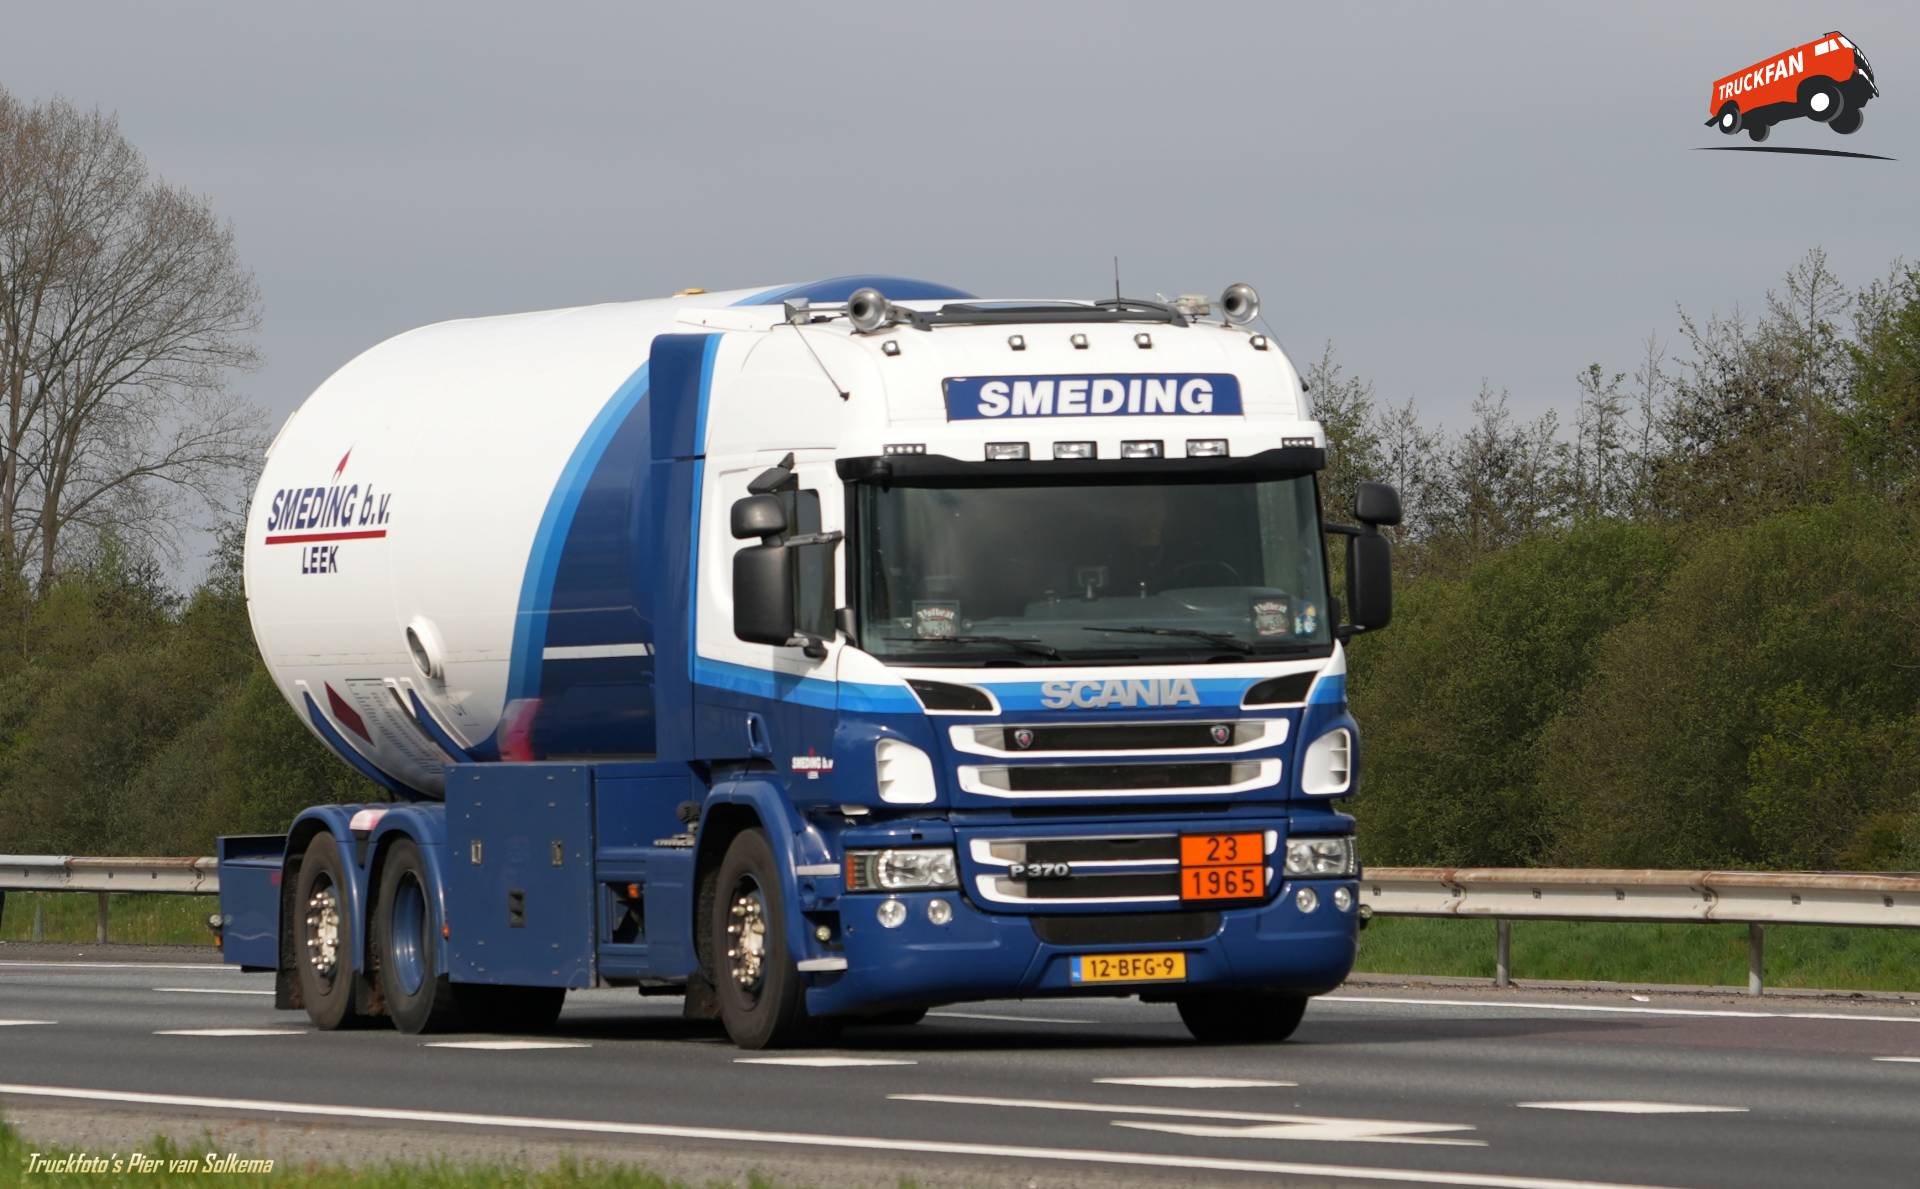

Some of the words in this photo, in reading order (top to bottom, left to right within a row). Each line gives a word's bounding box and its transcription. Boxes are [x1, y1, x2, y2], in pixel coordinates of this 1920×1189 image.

[977, 378, 1214, 417] SMEDING
[267, 484, 358, 532] SMEDING
[358, 483, 391, 526] b.v.
[302, 545, 339, 574] LEEK
[1040, 678, 1200, 710] SCANIA
[1206, 836, 1238, 862] 23
[1010, 865, 1025, 877] P
[1027, 863, 1070, 877] 370
[1193, 869, 1255, 896] 1965
[1091, 957, 1174, 977] 12-BFG-9
